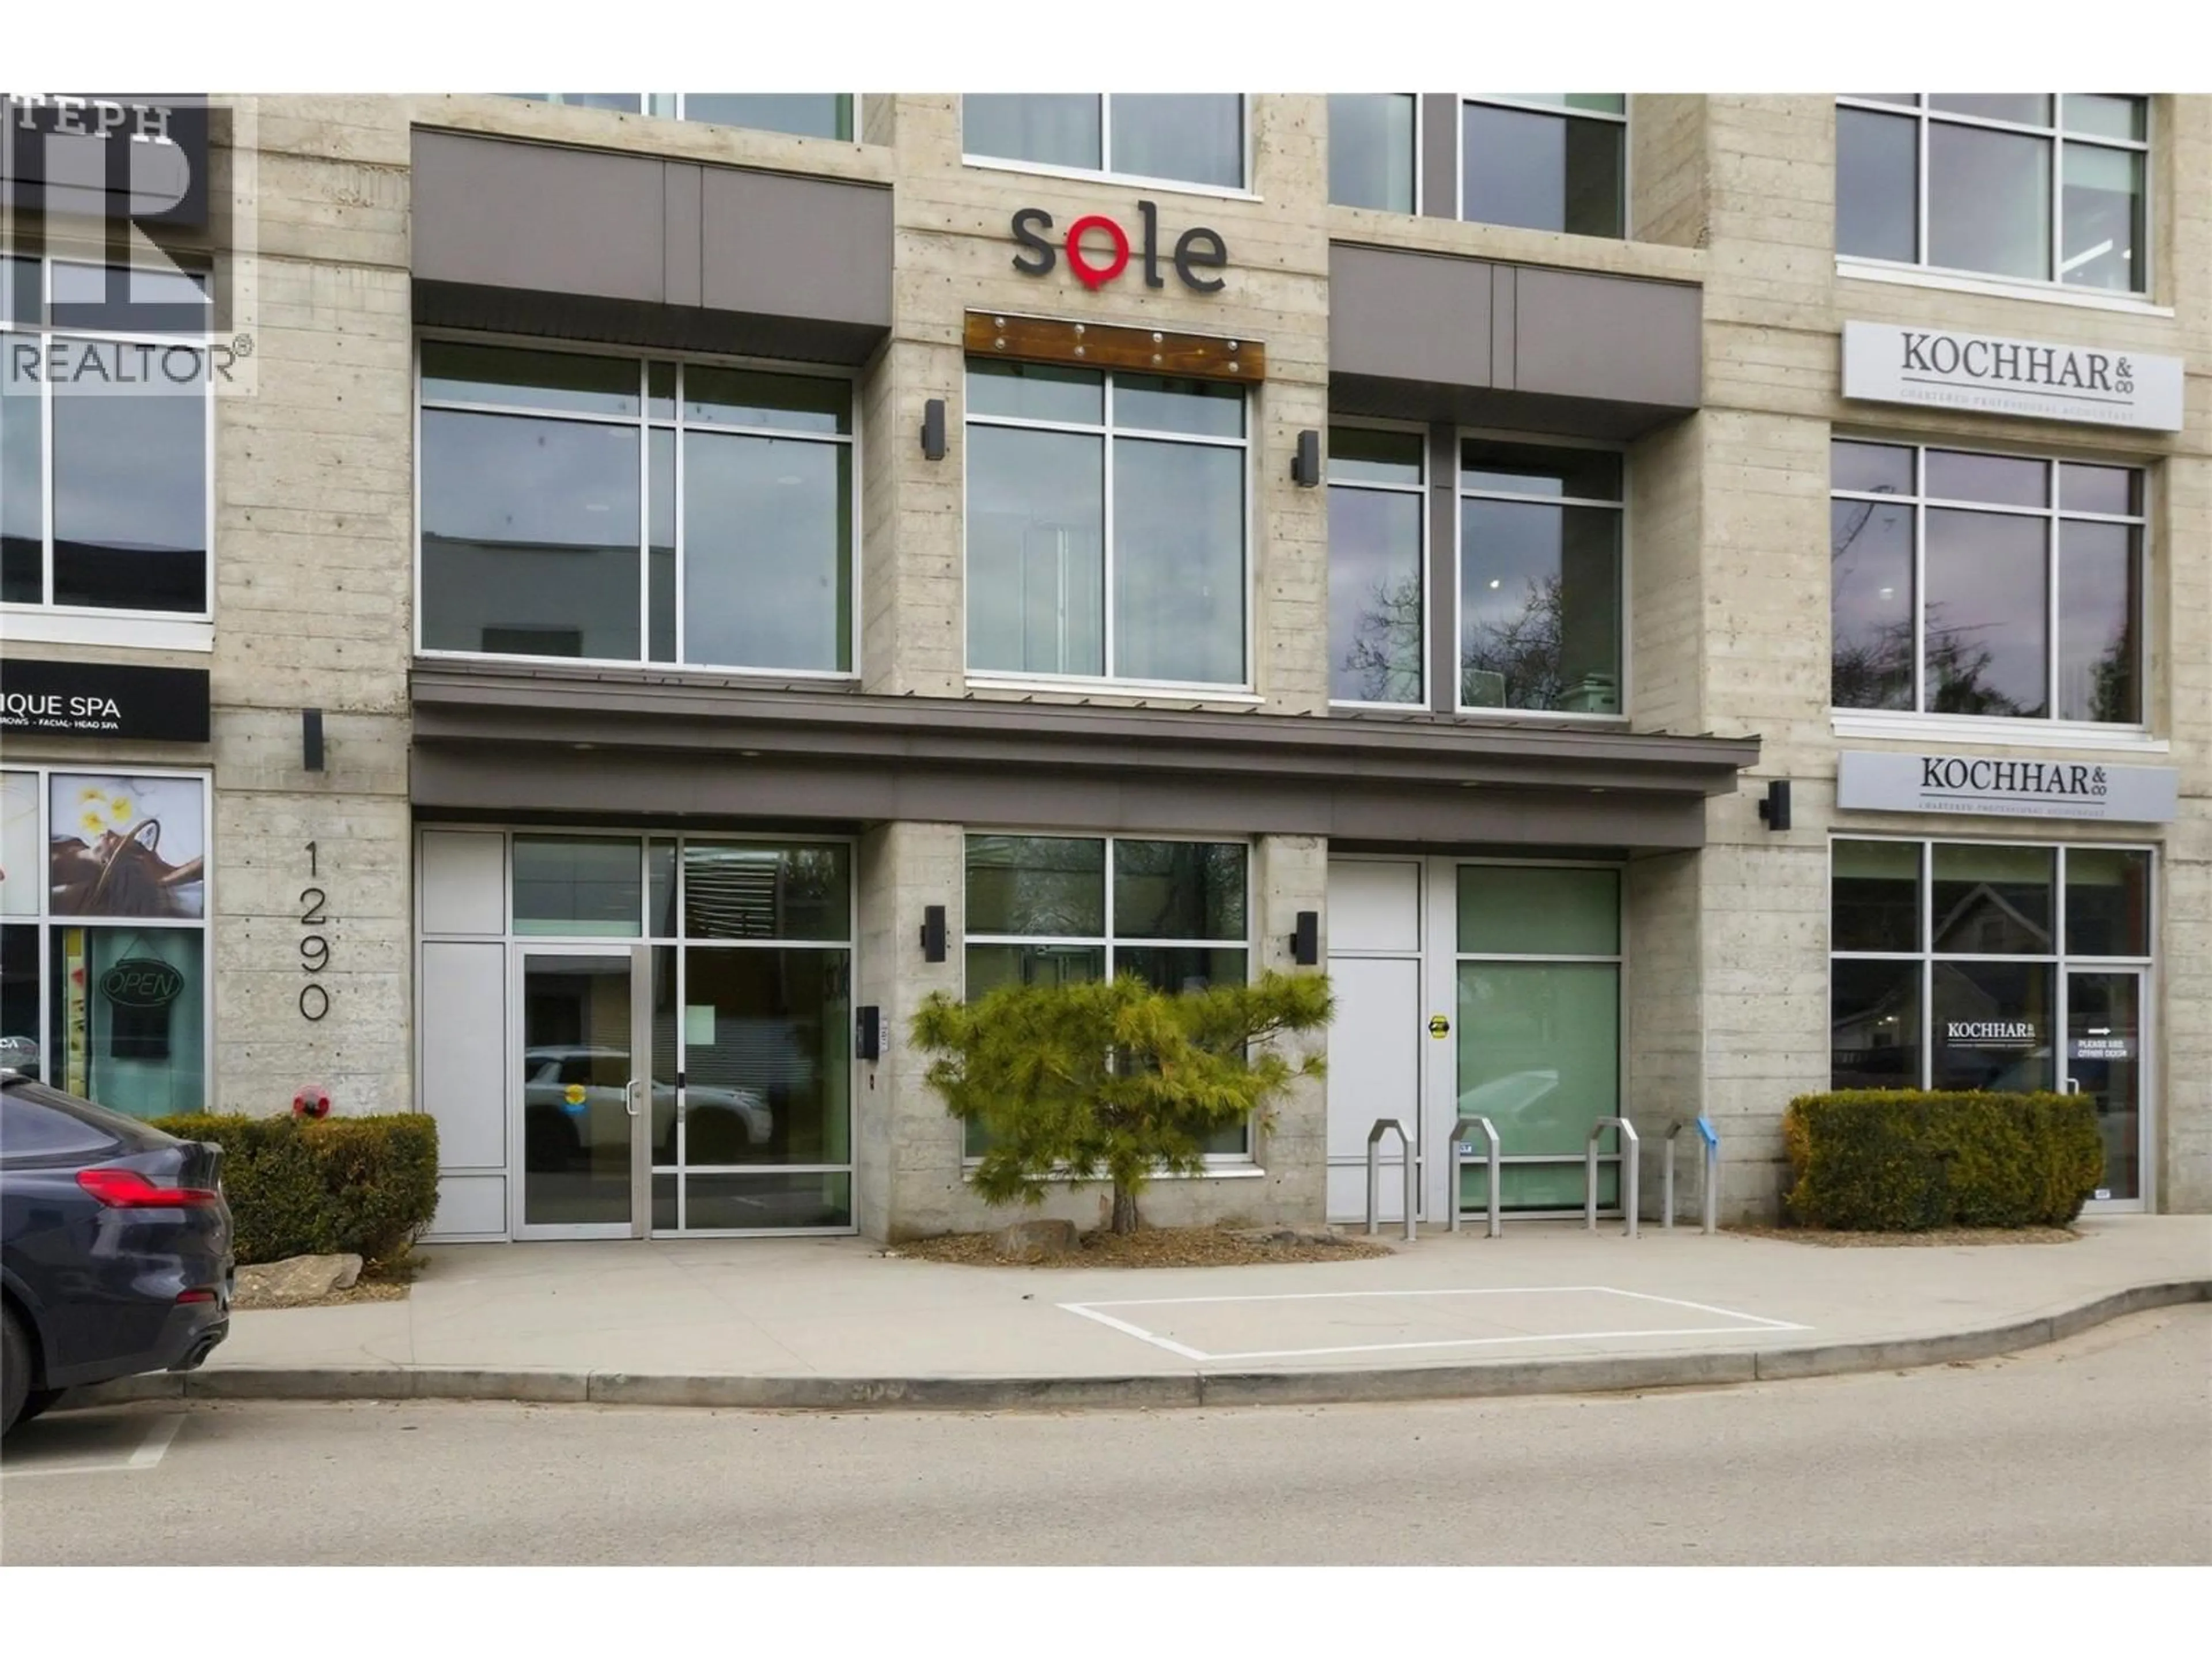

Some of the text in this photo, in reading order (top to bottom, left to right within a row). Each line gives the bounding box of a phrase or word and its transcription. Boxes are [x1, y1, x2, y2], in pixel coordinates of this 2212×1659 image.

[0, 93, 172, 145] TEPH
[1011, 200, 1228, 293] sole
[1900, 332, 2111, 391] KOCHHAR
[70, 697, 122, 718] SPA
[1920, 757, 2089, 794] KOCHHAR
[300, 840, 329, 1021] 1290
[107, 972, 175, 995] OPEN
[1947, 1022, 2028, 1037] KOCHHAR
